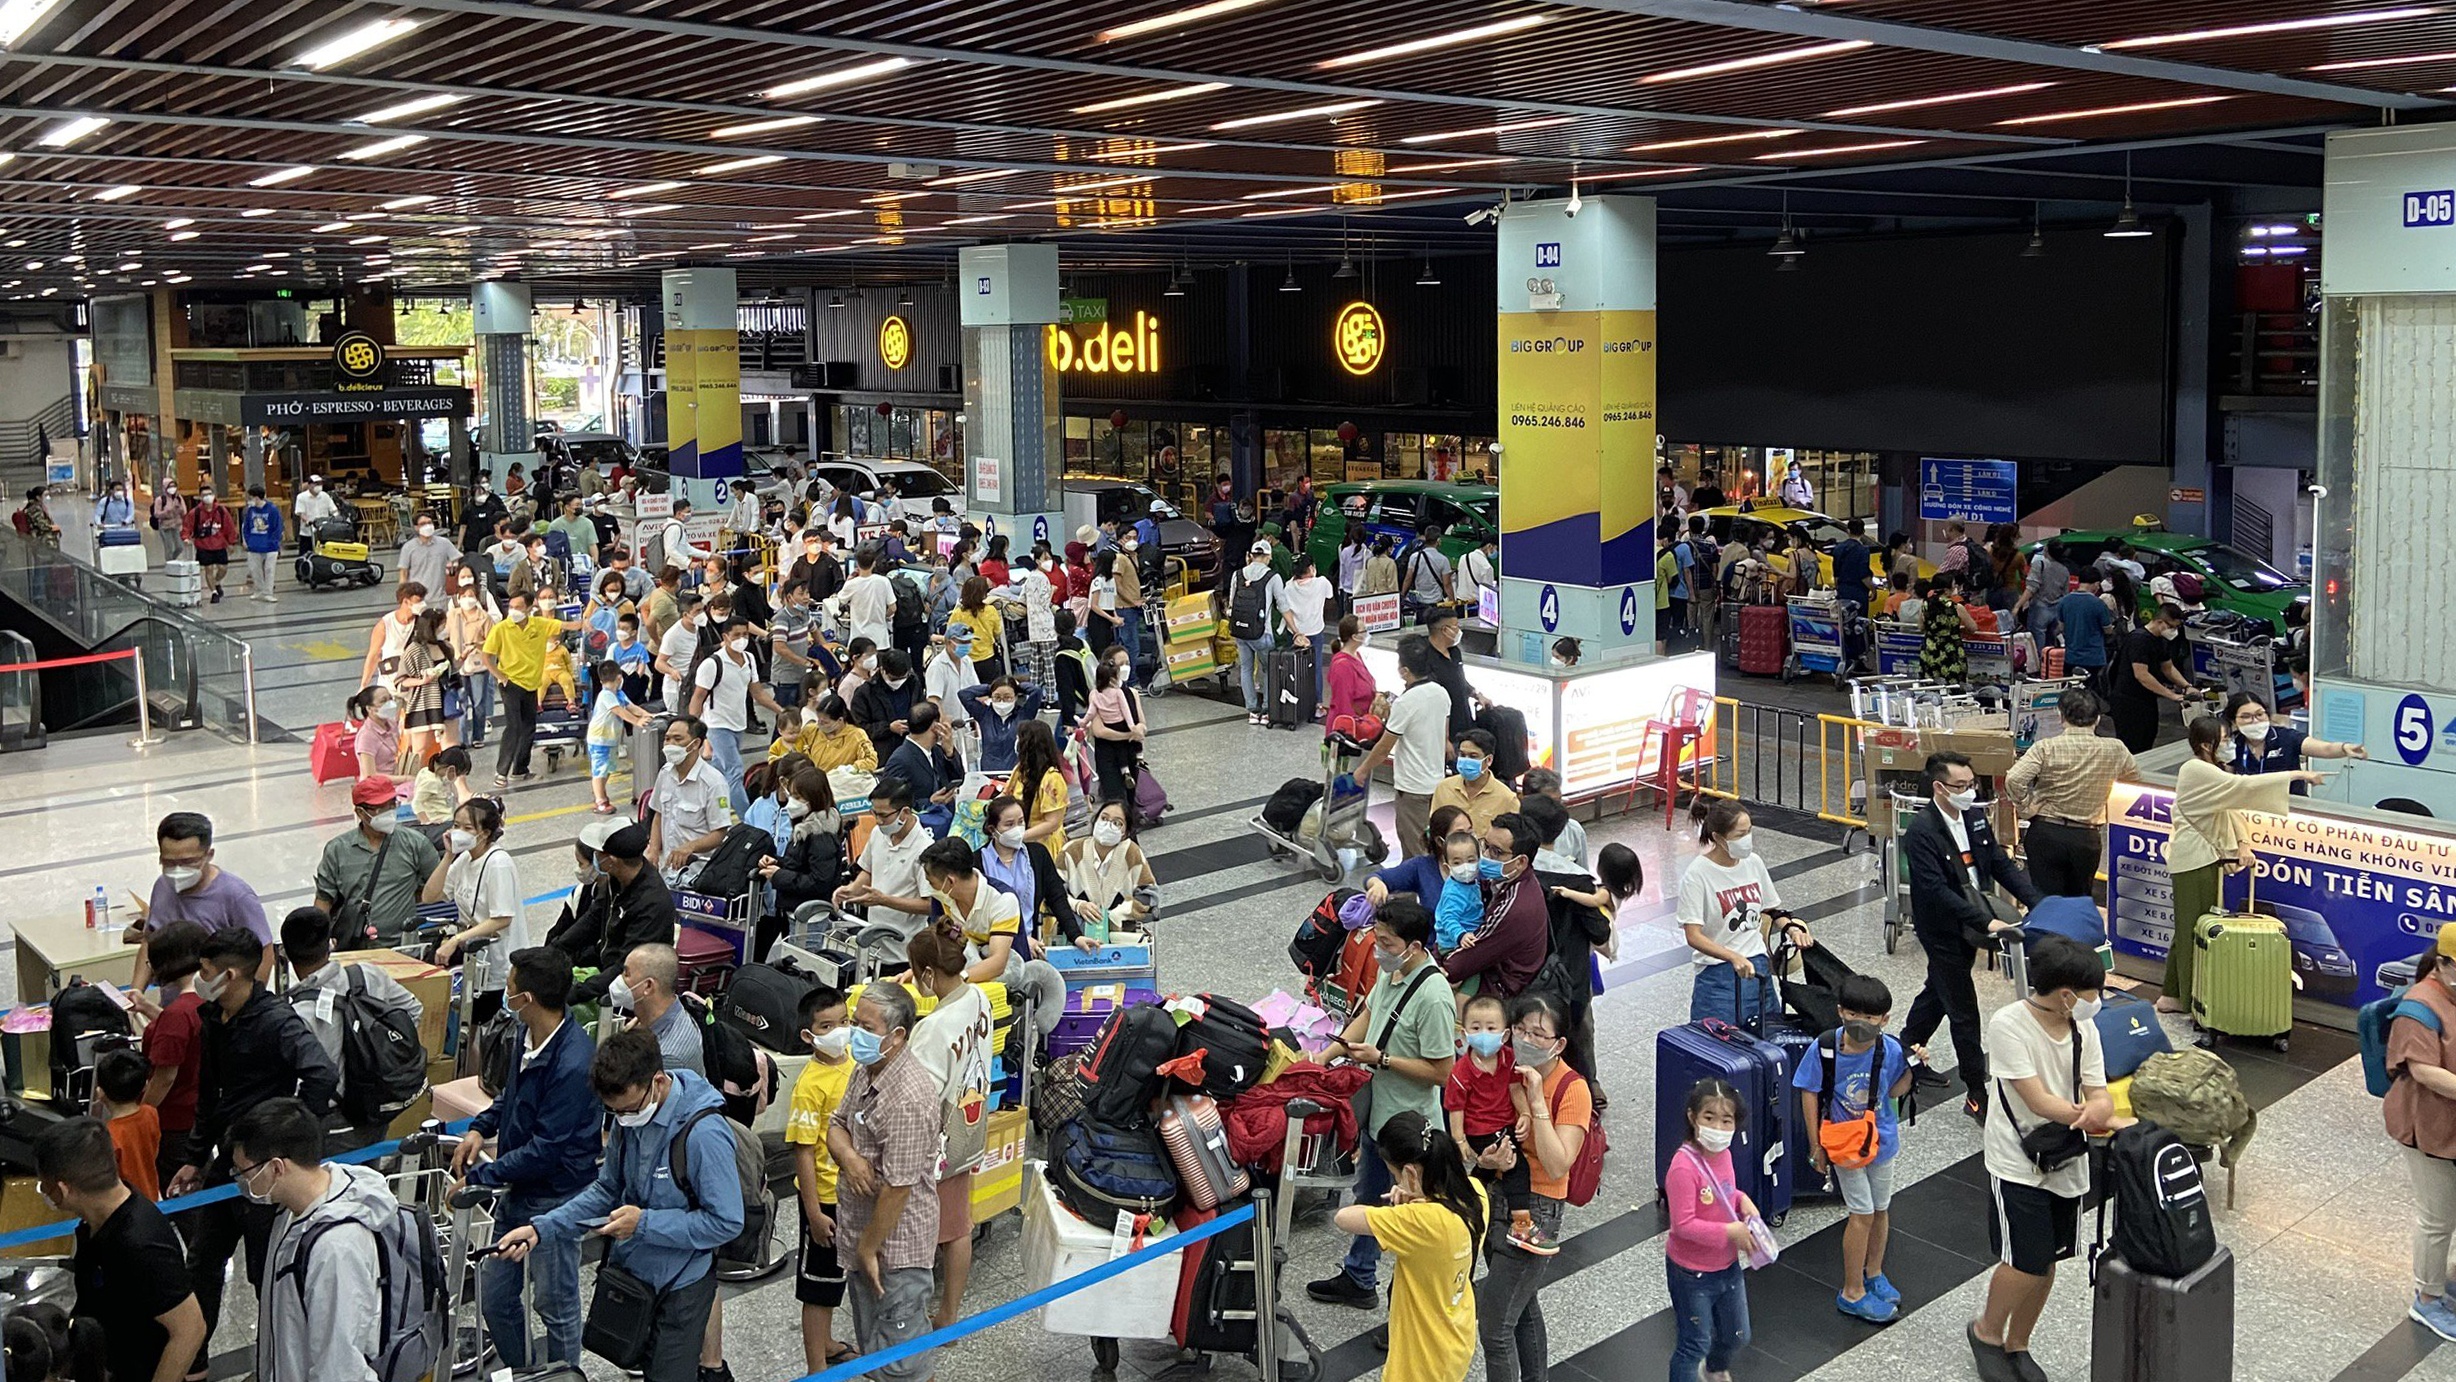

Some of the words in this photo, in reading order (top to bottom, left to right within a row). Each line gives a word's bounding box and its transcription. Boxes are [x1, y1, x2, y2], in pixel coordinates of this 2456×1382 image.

[2407, 195, 2451, 222] D-05
[1538, 246, 1558, 264] D-04
[1077, 305, 1106, 318] TAXI
[1511, 339, 1532, 353] BIG
[1534, 337, 1584, 355] GROUP
[1604, 342, 1618, 353] BIG
[1619, 339, 1652, 354] GROUP
[313, 401, 374, 414] ESPRESSO
[383, 398, 453, 412] BEVERAGES
[1511, 415, 1586, 428] 0965.246.846
[1603, 411, 1652, 422] 0965.246.846
[682, 483, 688, 499] 2
[716, 483, 726, 500] 2
[1971, 512, 1985, 521] D1
[987, 521, 994, 542] 3
[1035, 521, 1046, 541] 3
[1542, 594, 1557, 624] 4
[1622, 597, 1635, 626] 4
[2399, 707, 2428, 751] 5
[1880, 735, 1899, 743] TCL
[2269, 816, 2288, 829] TY
[2304, 839, 2352, 860] HÀNG
[2360, 852, 2423, 873] KHÔNG
[2145, 887, 2157, 897] XE
[2323, 871, 2394, 904] TIỄN
[2145, 908, 2157, 918] XE
[2141, 928, 2154, 938] XE
[2158, 932, 2170, 942] 16
